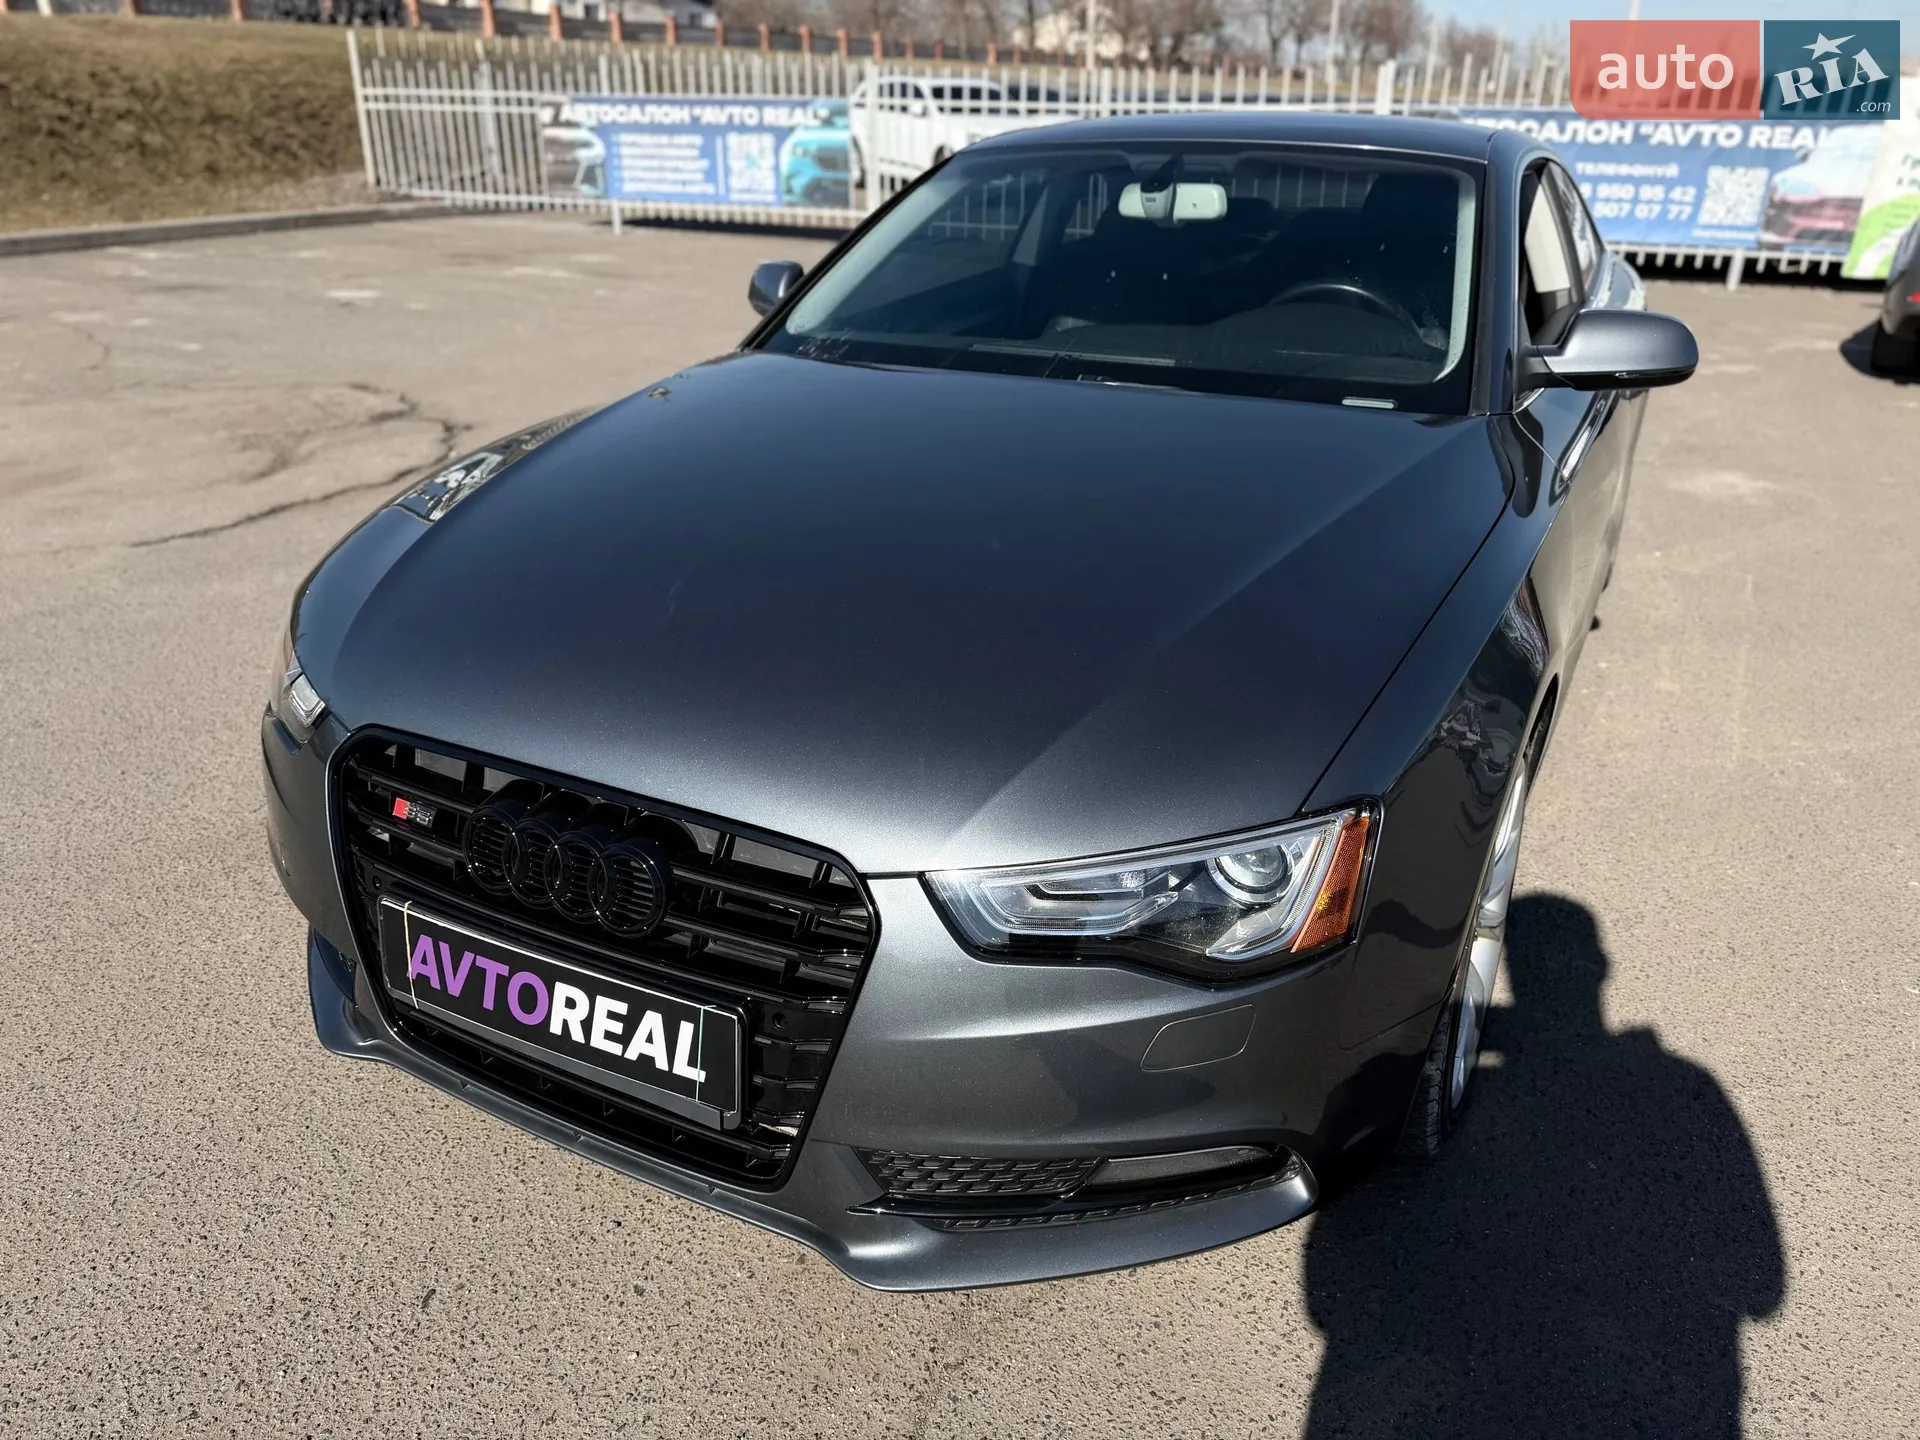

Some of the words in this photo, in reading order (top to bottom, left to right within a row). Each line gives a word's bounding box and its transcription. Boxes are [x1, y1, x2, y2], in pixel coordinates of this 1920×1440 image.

[1634, 202, 1662, 220] 07
[1667, 204, 1693, 221] 77
[407, 934, 706, 1083] AVTOREAL
